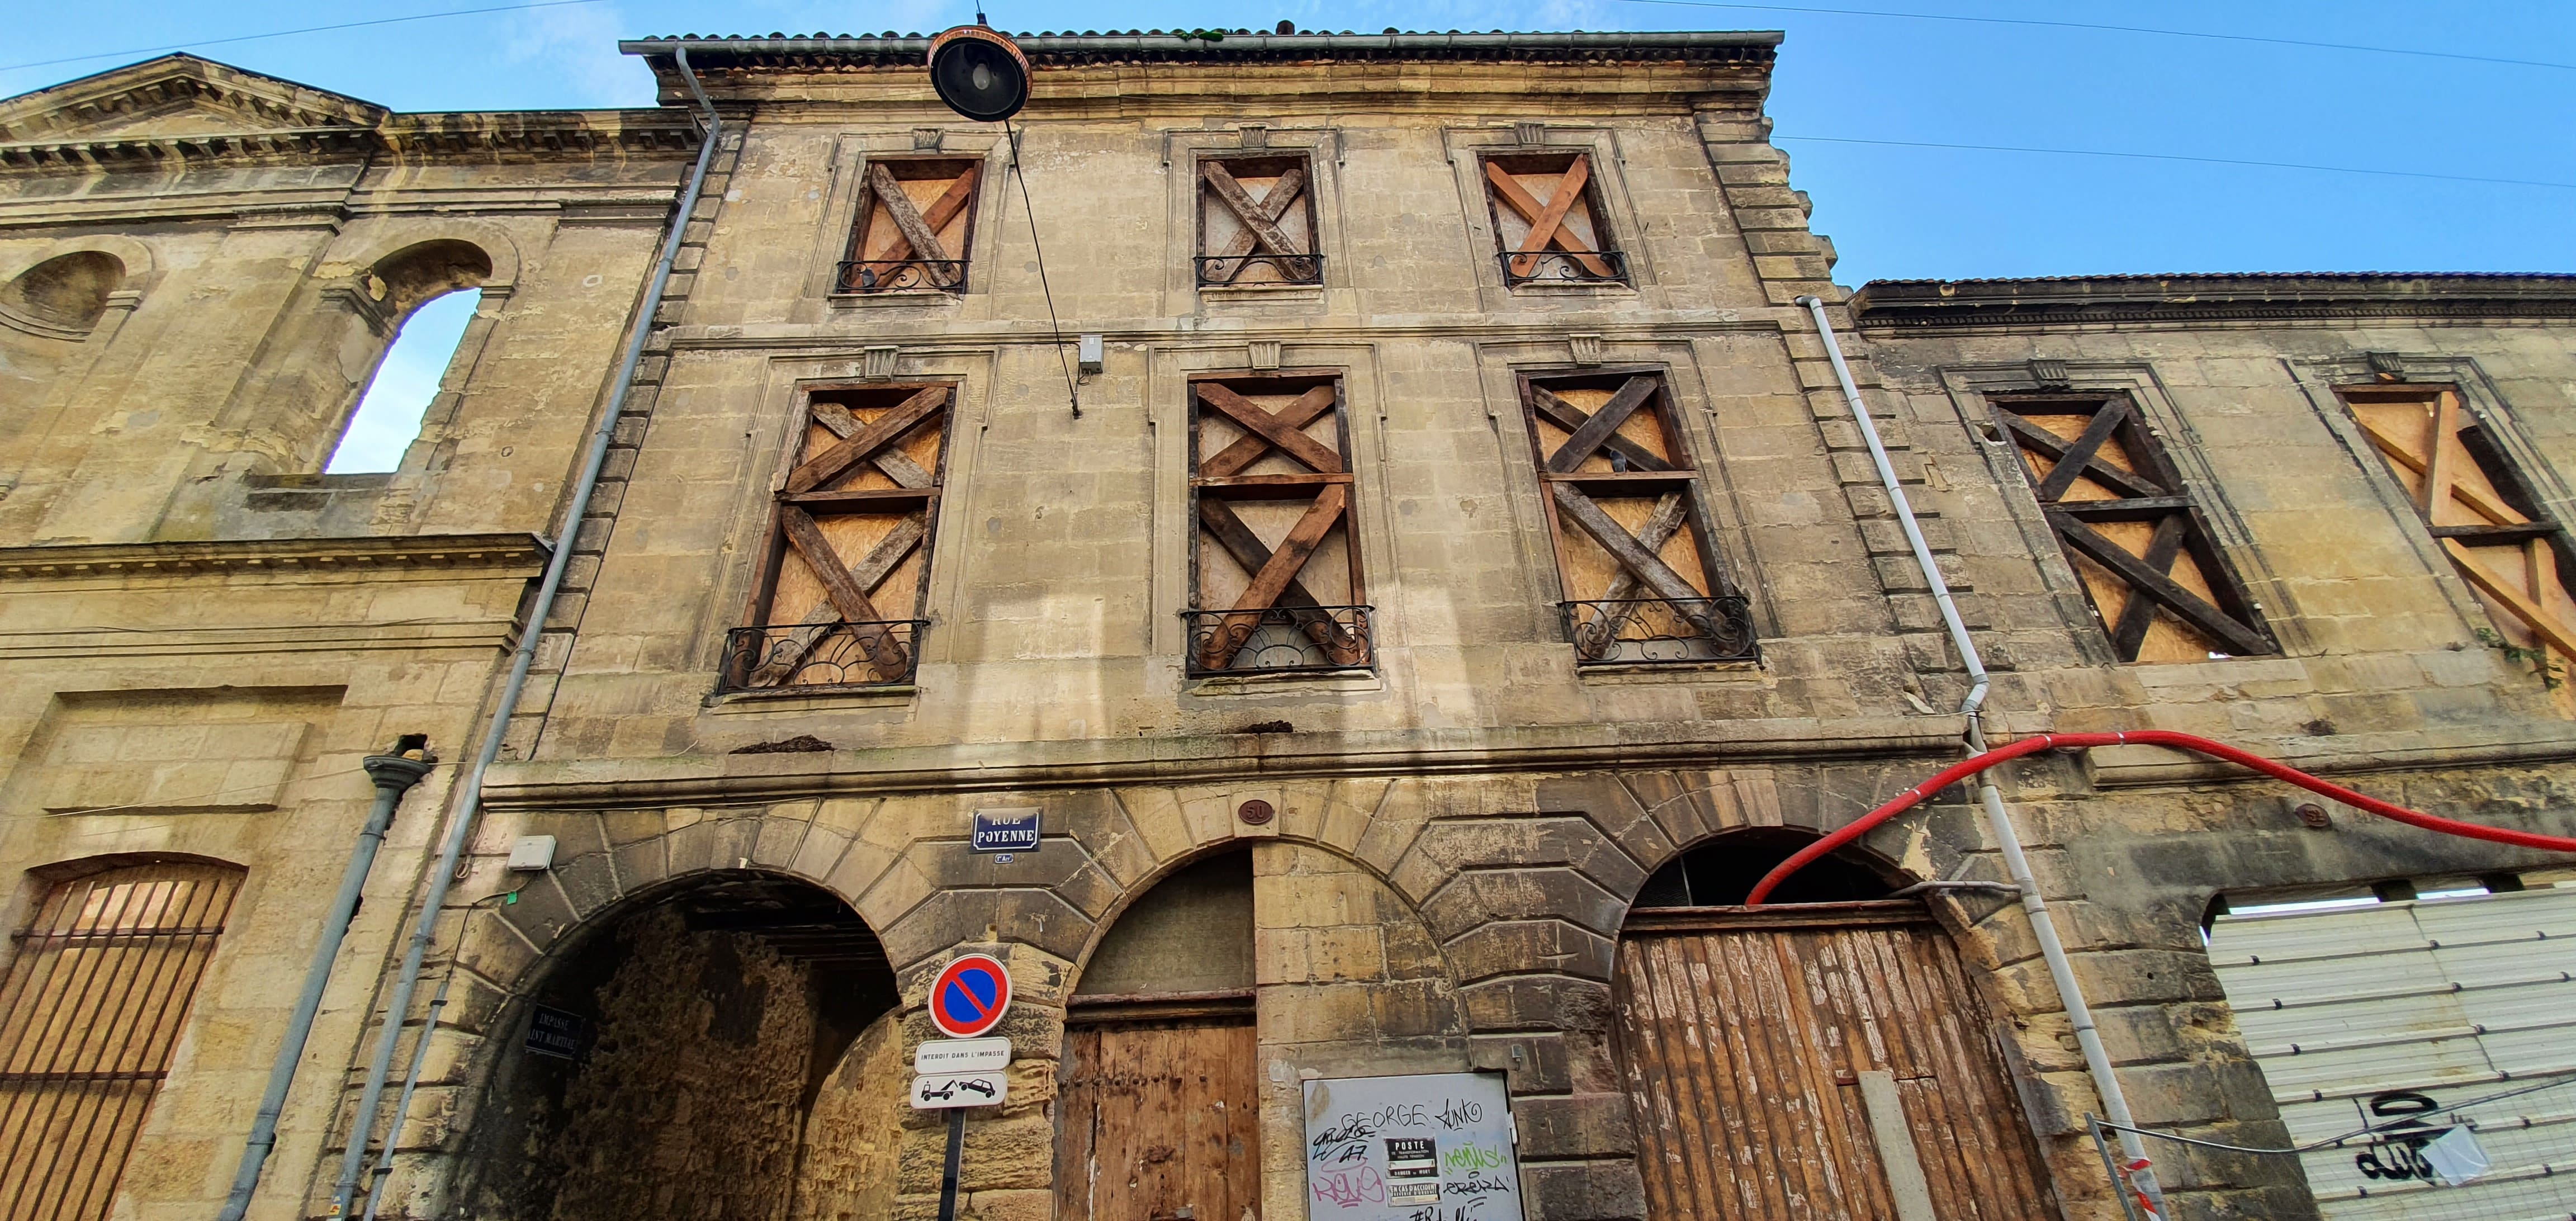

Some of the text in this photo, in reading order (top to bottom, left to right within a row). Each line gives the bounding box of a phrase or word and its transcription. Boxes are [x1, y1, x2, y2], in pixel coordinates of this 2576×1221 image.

[1247, 806, 1265, 818] 50
[992, 816, 1020, 826] RUE
[977, 830, 1034, 843] POYENNE
[538, 1012, 570, 1031] IMPASSE
[1342, 1104, 1428, 1130] GEORGE
[1395, 1141, 1424, 1151] POSTE
